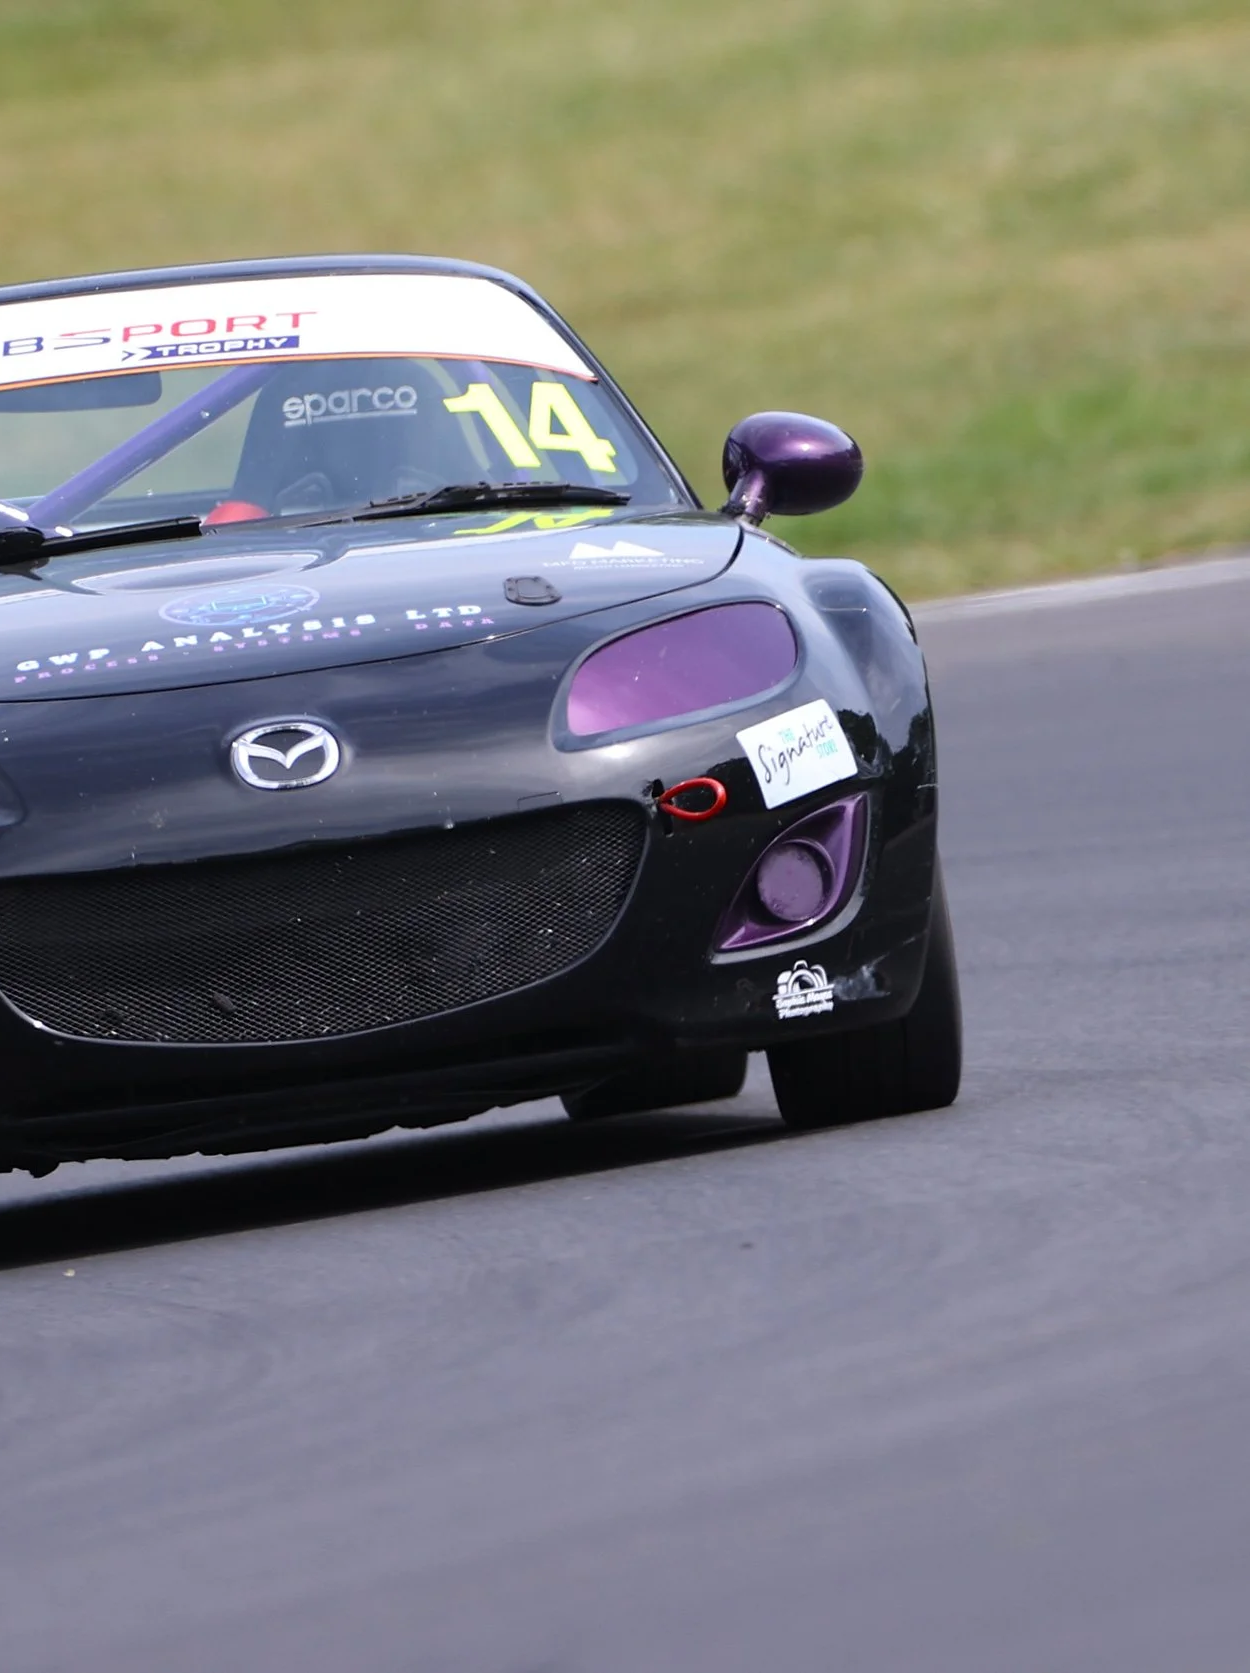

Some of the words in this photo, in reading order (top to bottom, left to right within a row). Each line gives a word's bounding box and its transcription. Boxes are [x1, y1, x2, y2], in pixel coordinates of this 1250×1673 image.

[155, 336, 288, 358] TROPHY
[282, 385, 418, 427] sparco
[443, 381, 617, 473] 14
[14, 654, 159, 684] PROCESS
[213, 629, 362, 653] SYSTEMS
[414, 616, 495, 630] DATA
[17, 648, 110, 672] GWP
[141, 614, 376, 652] ANALYSIS
[405, 605, 482, 620] LTD
[758, 715, 834, 786] Signature
